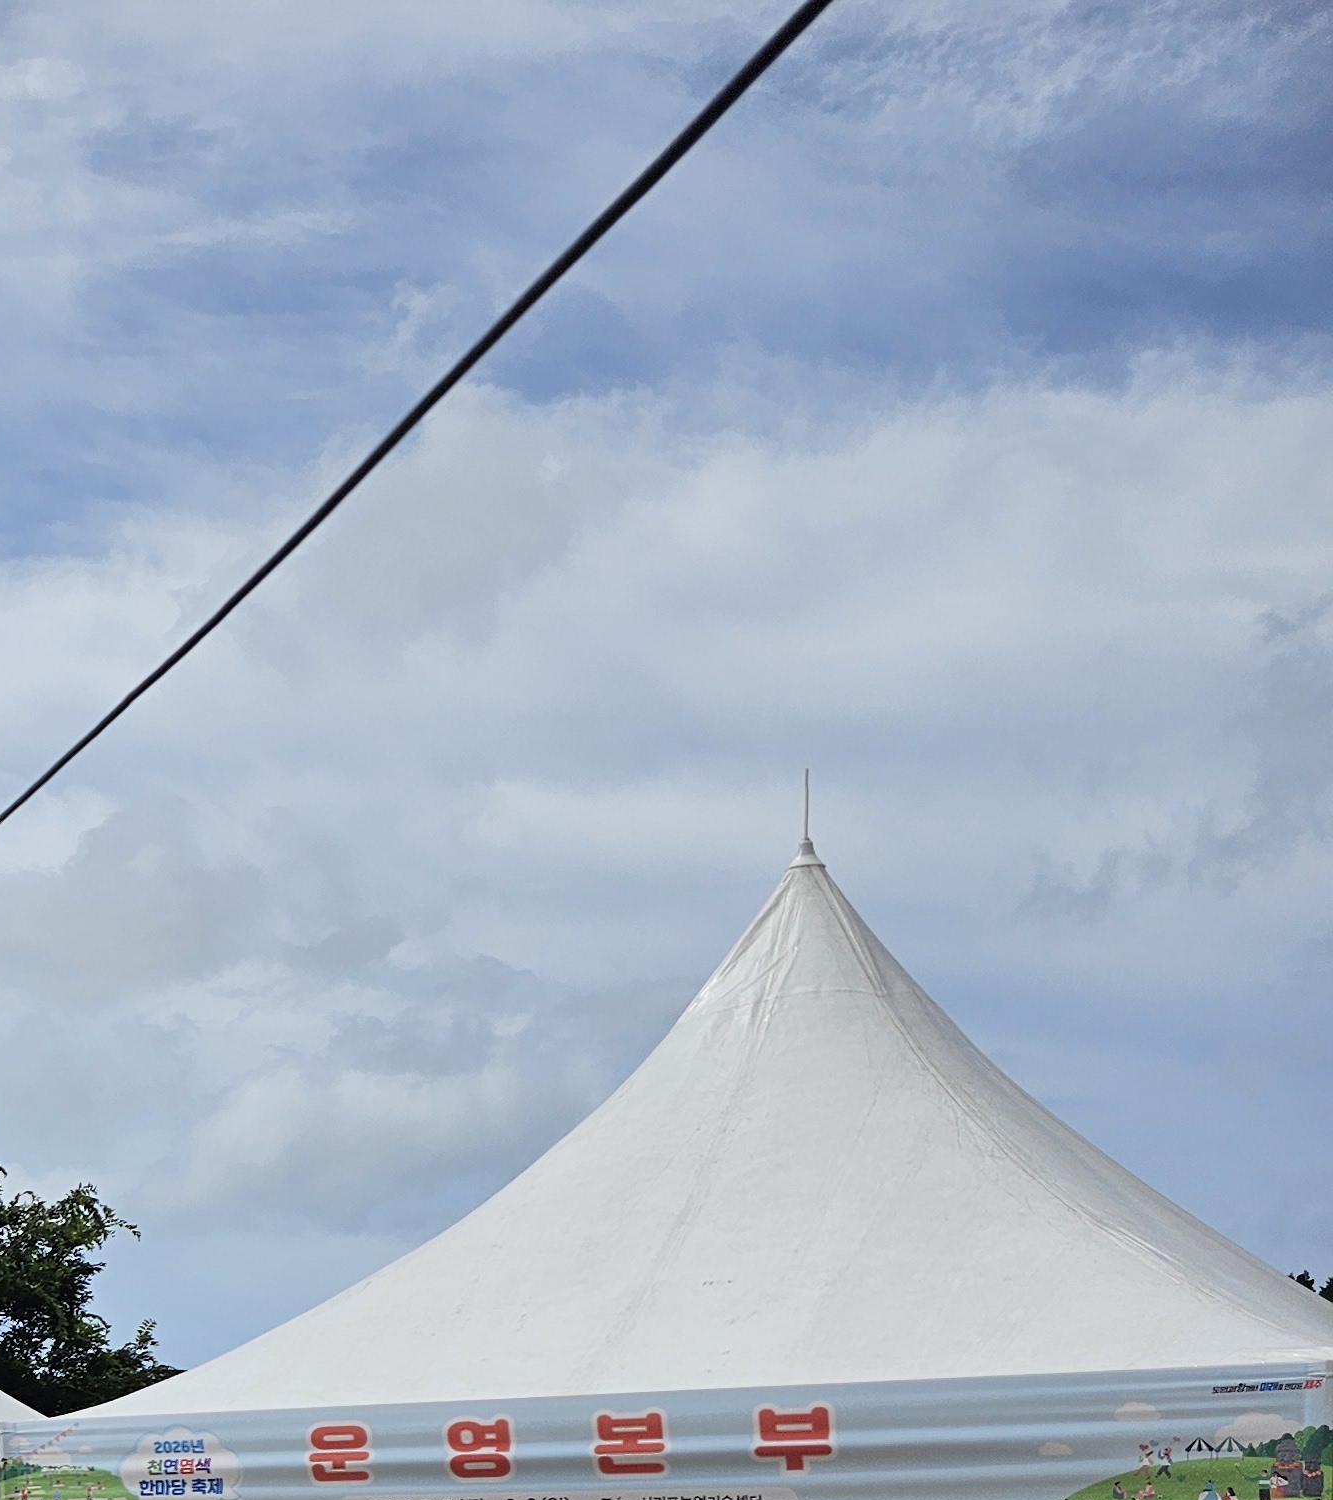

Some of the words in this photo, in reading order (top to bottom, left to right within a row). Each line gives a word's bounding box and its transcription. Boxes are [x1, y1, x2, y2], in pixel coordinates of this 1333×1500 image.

[153, 1438, 206, 1455] 2026년
[146, 1457, 212, 1476] 천연염색
[138, 1478, 188, 1497] 한마당
[191, 1477, 224, 1495] 축제
